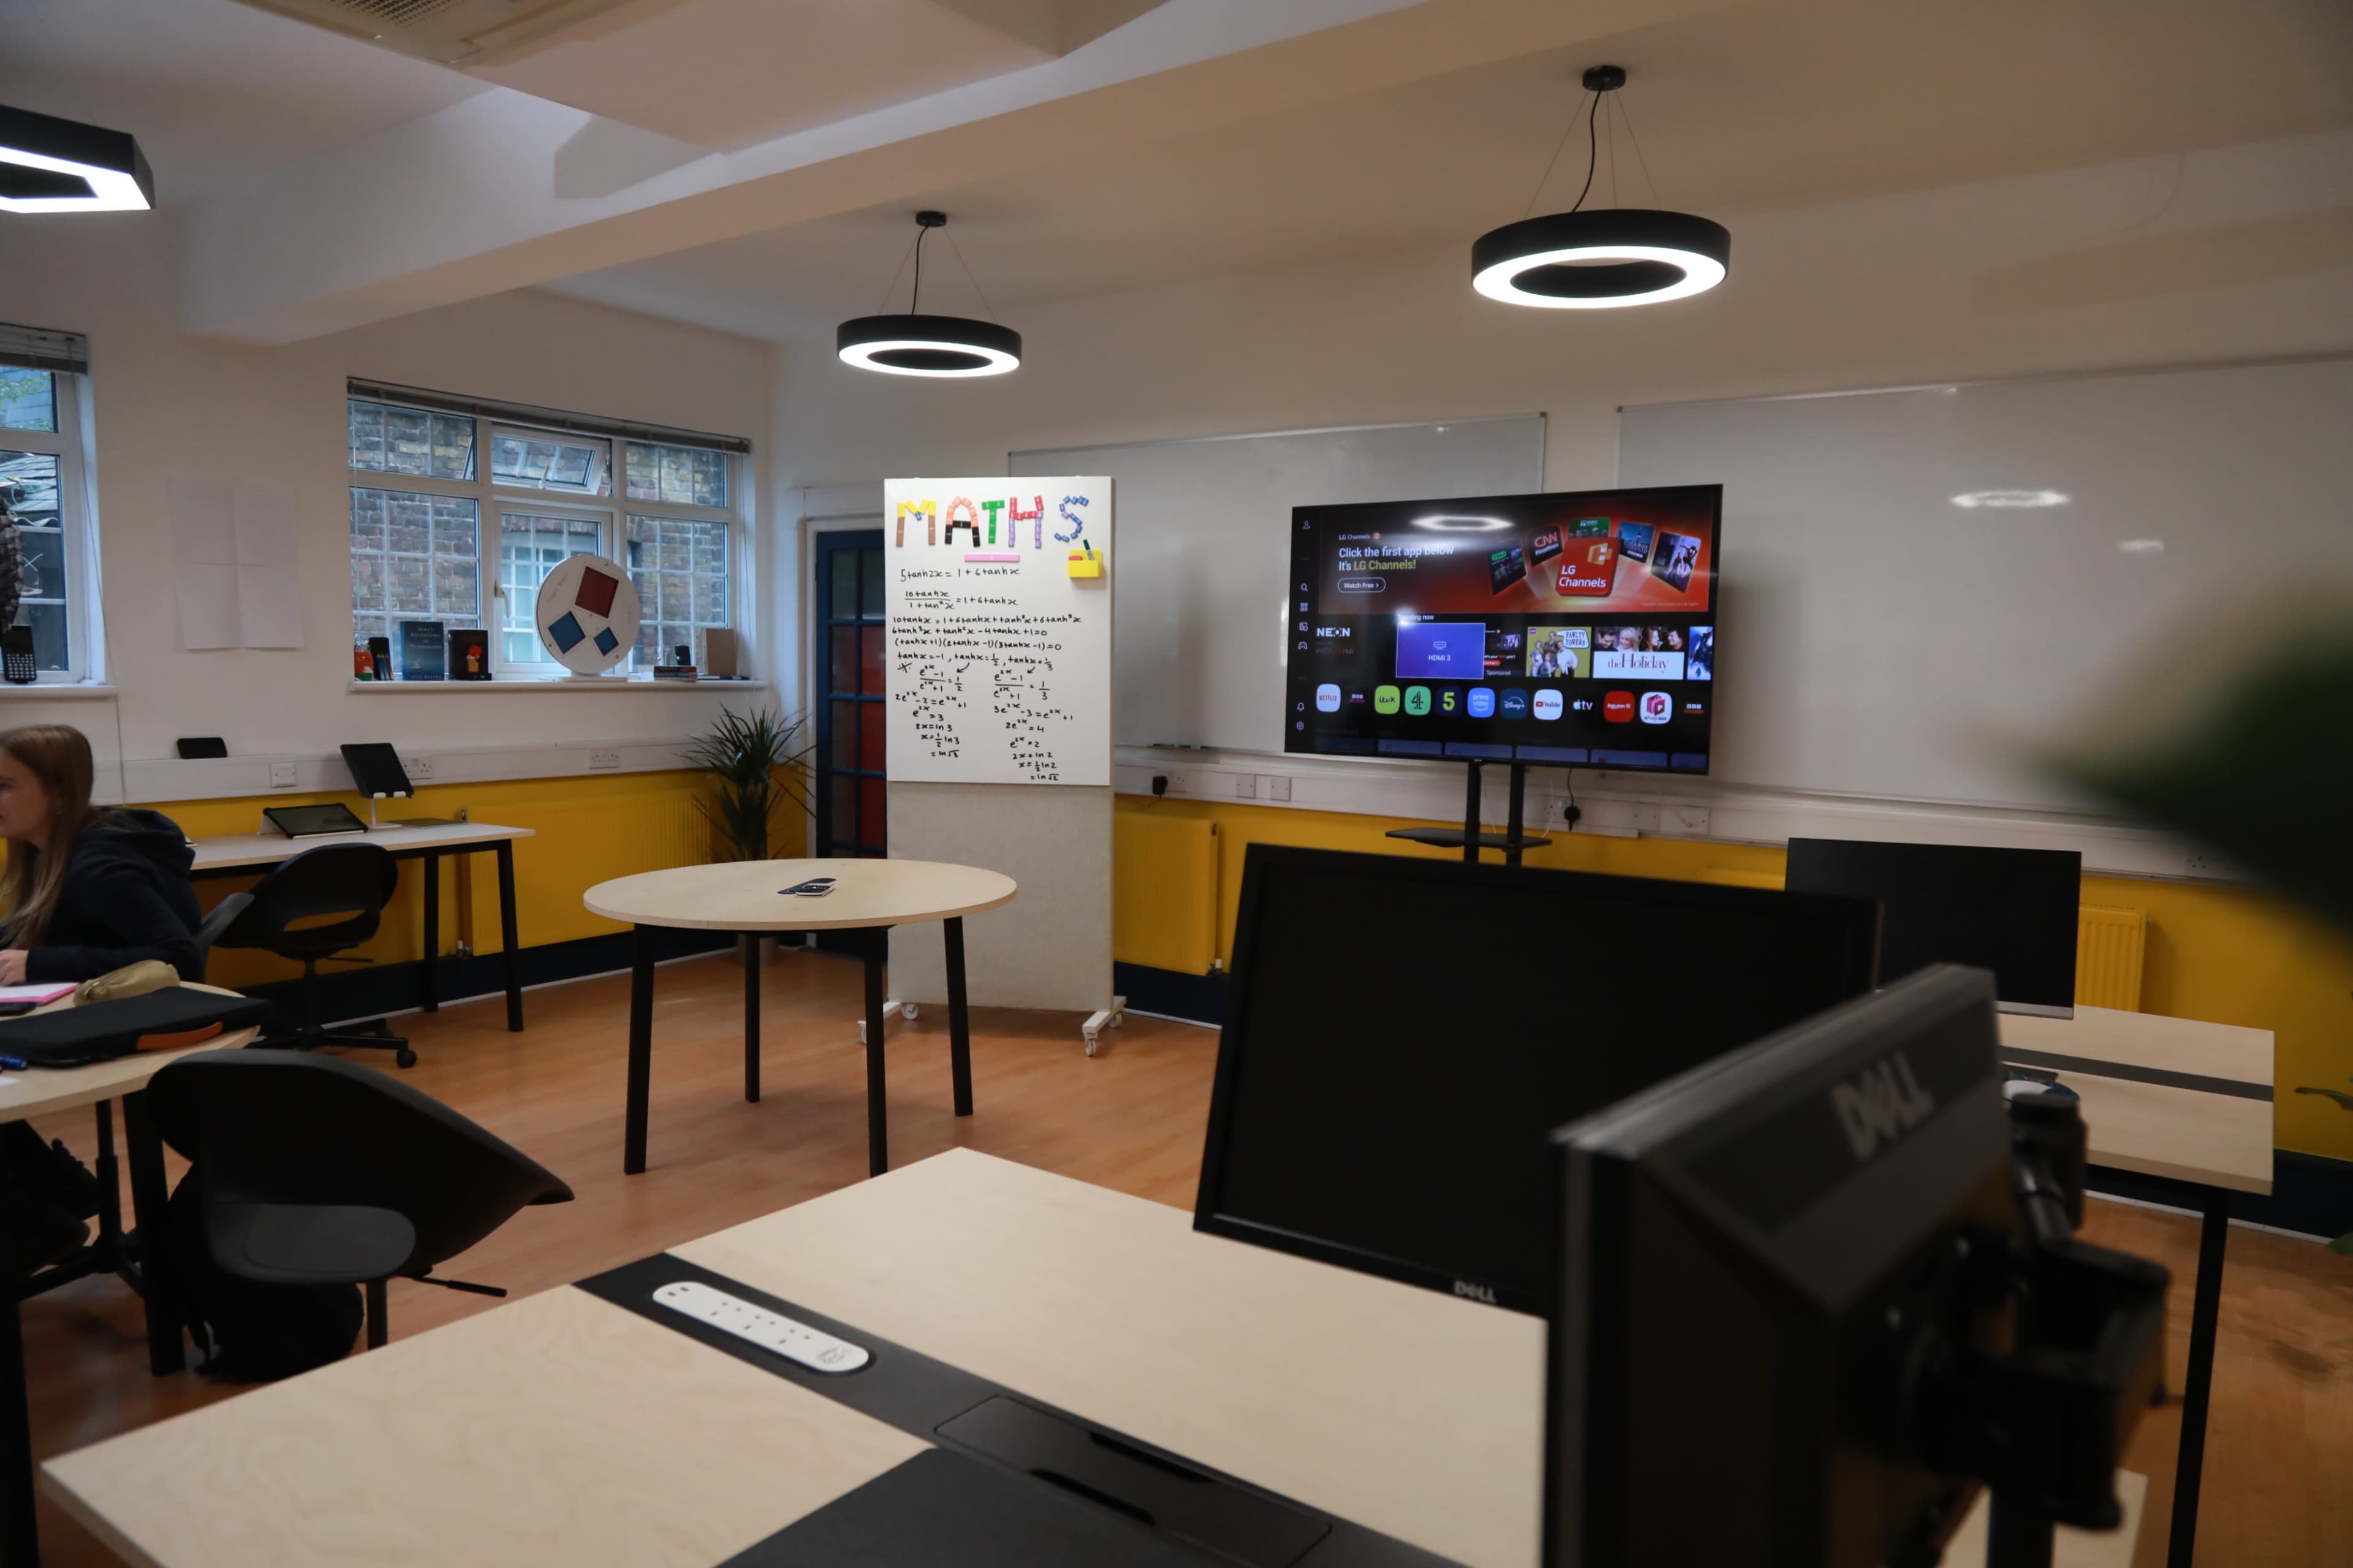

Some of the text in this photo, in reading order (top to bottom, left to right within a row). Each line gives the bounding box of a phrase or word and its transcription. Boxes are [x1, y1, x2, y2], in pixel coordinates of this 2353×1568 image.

[896, 495, 1089, 549] MATHS
[1534, 531, 1558, 548] CNN
[1339, 545, 1454, 558] Click the first app below
[1339, 559, 1416, 571] It's LG Channels!
[1561, 566, 1576, 575] LG
[1559, 576, 1606, 588] Channels
[1317, 627, 1351, 637] NEON
[1608, 653, 1668, 673] the Holiday
[1411, 691, 1423, 710] 4
[1442, 692, 1455, 711] 5
[1582, 701, 1593, 710] tv
[1454, 1280, 1497, 1303] DELL
